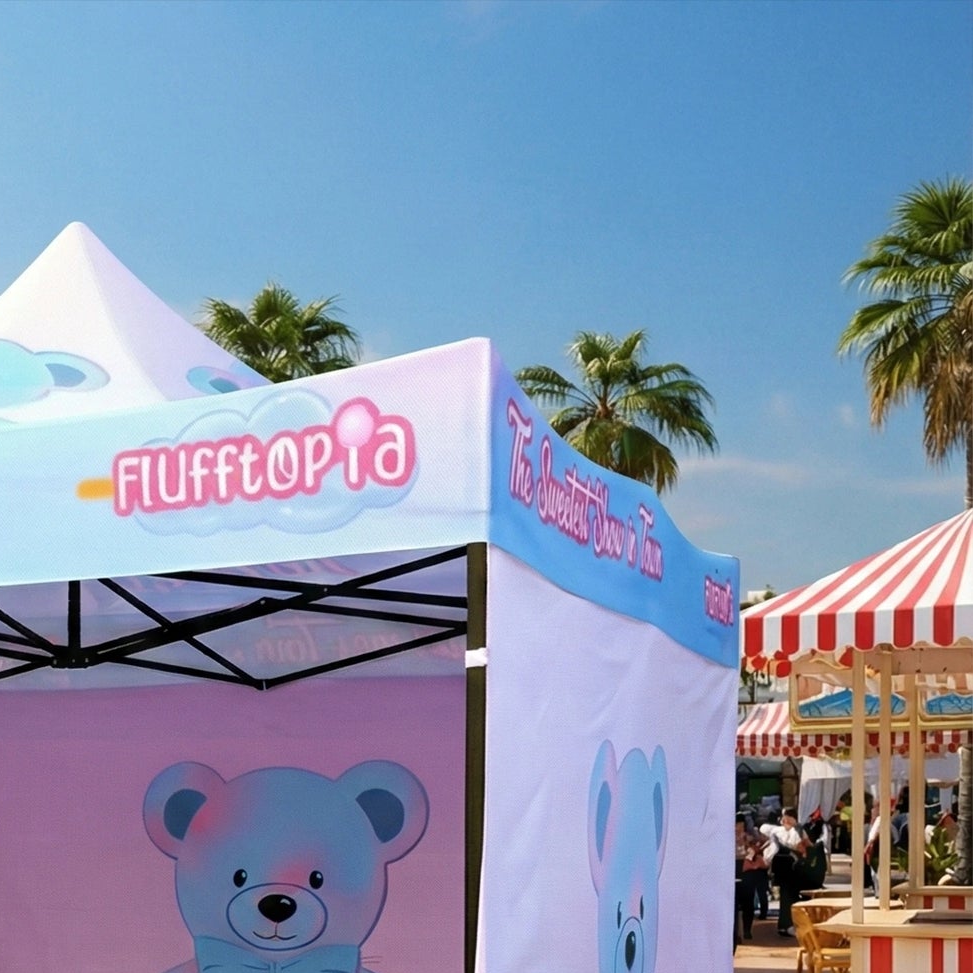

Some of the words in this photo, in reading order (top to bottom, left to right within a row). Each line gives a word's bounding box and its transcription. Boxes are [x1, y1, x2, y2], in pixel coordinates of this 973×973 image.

[507, 398, 534, 508] The
[537, 436, 592, 545] Sweetest
[593, 478, 625, 559] Show
[627, 516, 637, 568] in
[639, 502, 663, 582] Town
